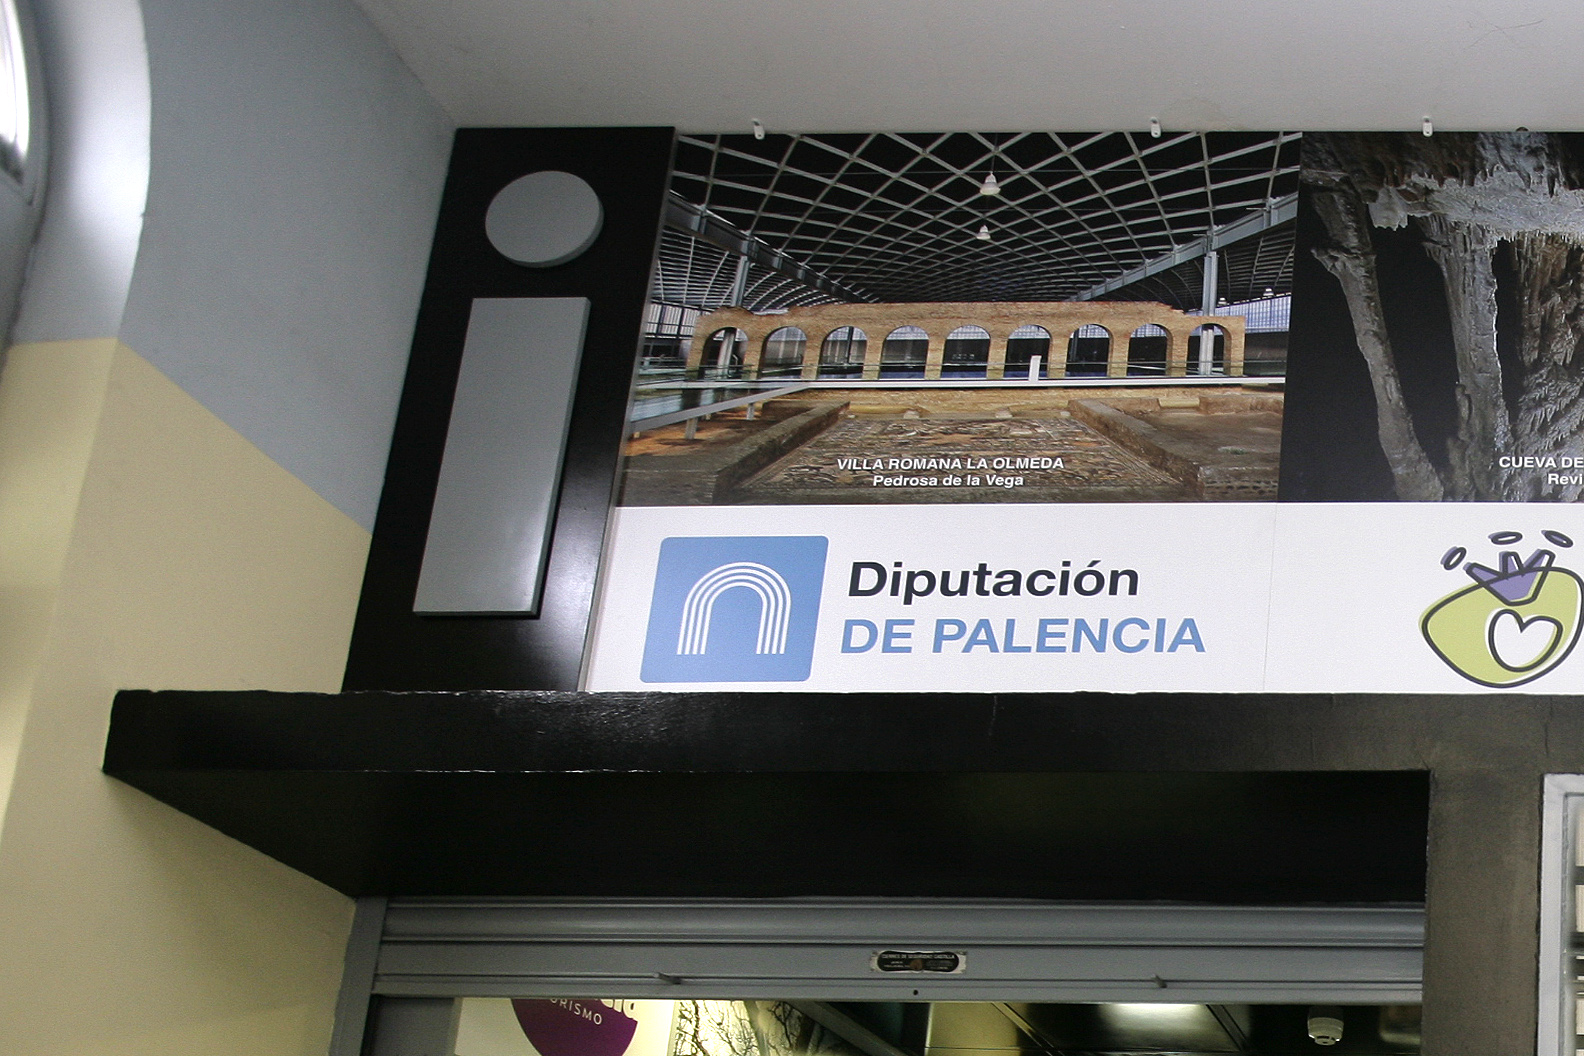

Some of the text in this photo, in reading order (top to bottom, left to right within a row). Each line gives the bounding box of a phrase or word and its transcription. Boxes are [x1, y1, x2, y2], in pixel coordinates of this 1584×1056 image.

[837, 457, 1064, 470] VILLA ROMANA LA OLMEDA
[1499, 456, 1557, 468] CUEVA
[1561, 457, 1584, 469] DE
[873, 474, 1024, 489] Pedrosa de la Vega
[848, 560, 1139, 606] Diputación
[840, 617, 1206, 654] DE PALENCIA
[550, 998, 602, 1025] RISMO
